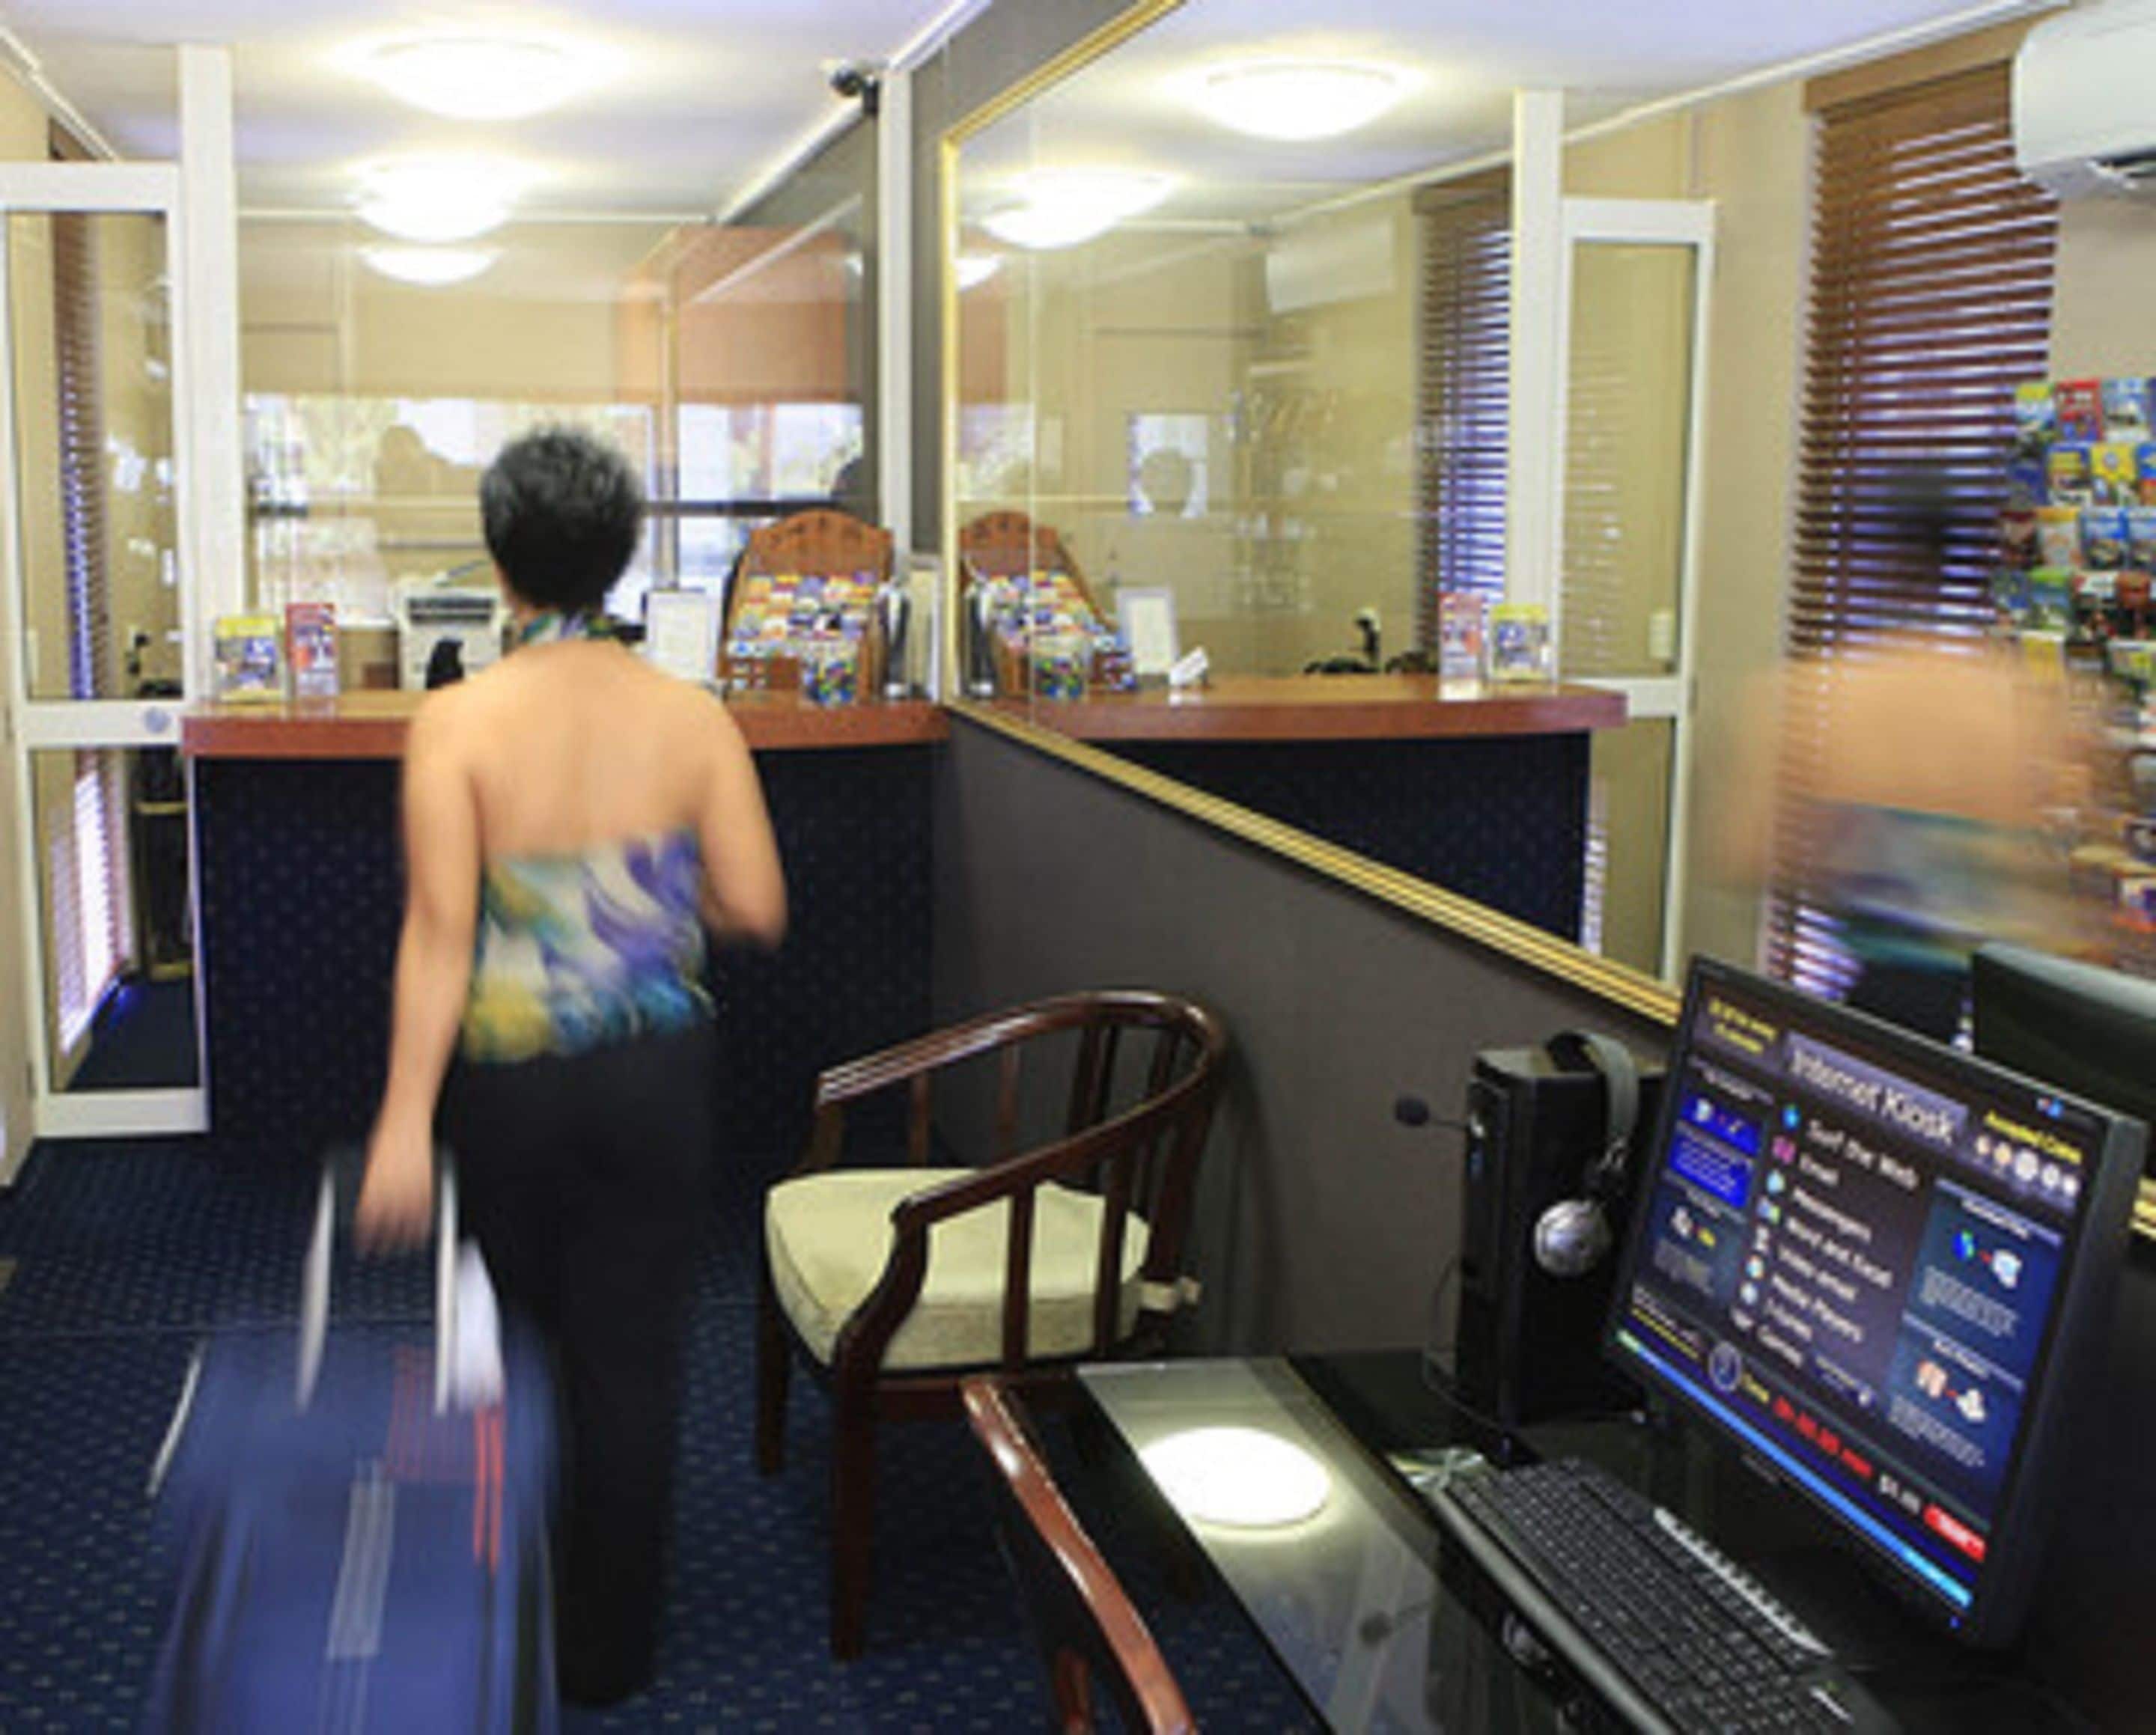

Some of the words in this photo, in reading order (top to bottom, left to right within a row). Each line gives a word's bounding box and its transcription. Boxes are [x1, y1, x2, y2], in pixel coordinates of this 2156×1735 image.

[1790, 1047, 1881, 1112] Internet
[1881, 1085, 1952, 1146] Kiosk
[1806, 1120, 1845, 1153] Surf
